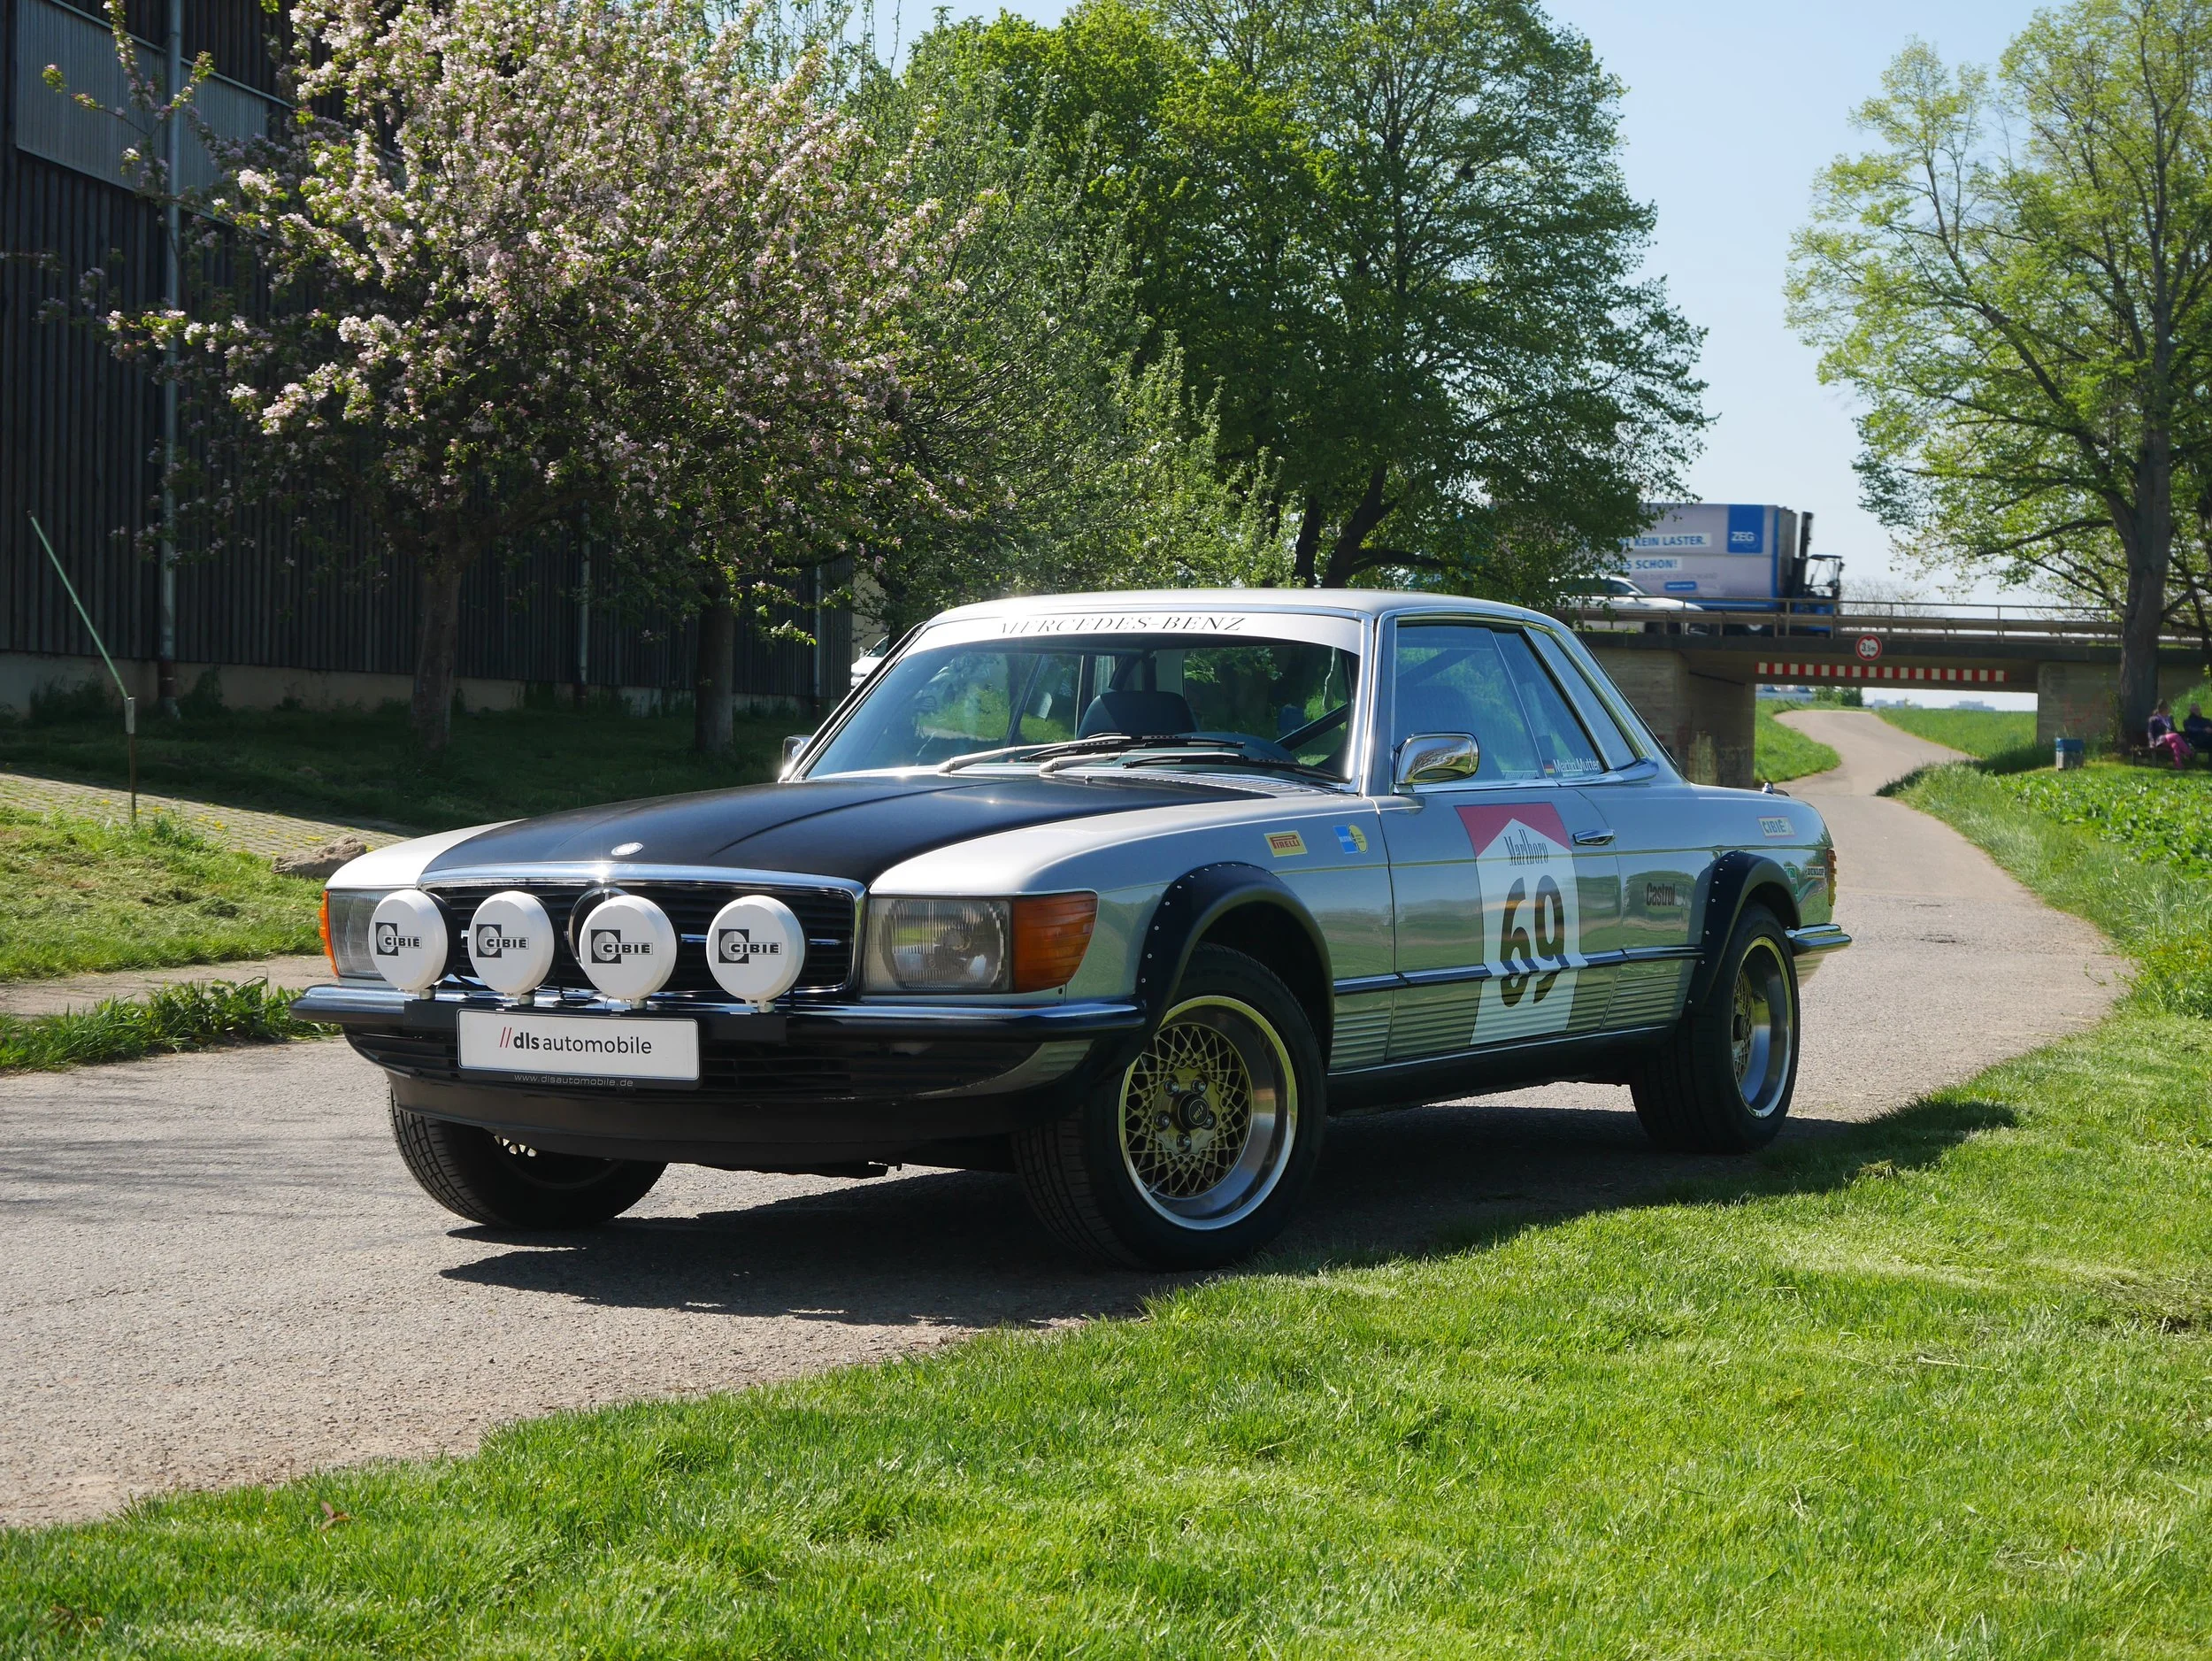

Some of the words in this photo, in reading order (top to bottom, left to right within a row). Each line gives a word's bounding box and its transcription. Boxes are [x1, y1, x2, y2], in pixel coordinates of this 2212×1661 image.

[1634, 536, 1659, 547] KEIN
[1663, 535, 1706, 546] LASTER.
[1730, 531, 1755, 542] ZEG
[1553, 759, 1575, 773] Martin
[1269, 834, 1300, 850] PIRELLI
[1504, 829, 1548, 866] Marlboro
[1647, 882, 1675, 906] Castrol
[1500, 874, 1564, 1007] 69
[542, 1035, 652, 1054] automobile
[514, 1073, 634, 1088] www.dlsautomobile.de
